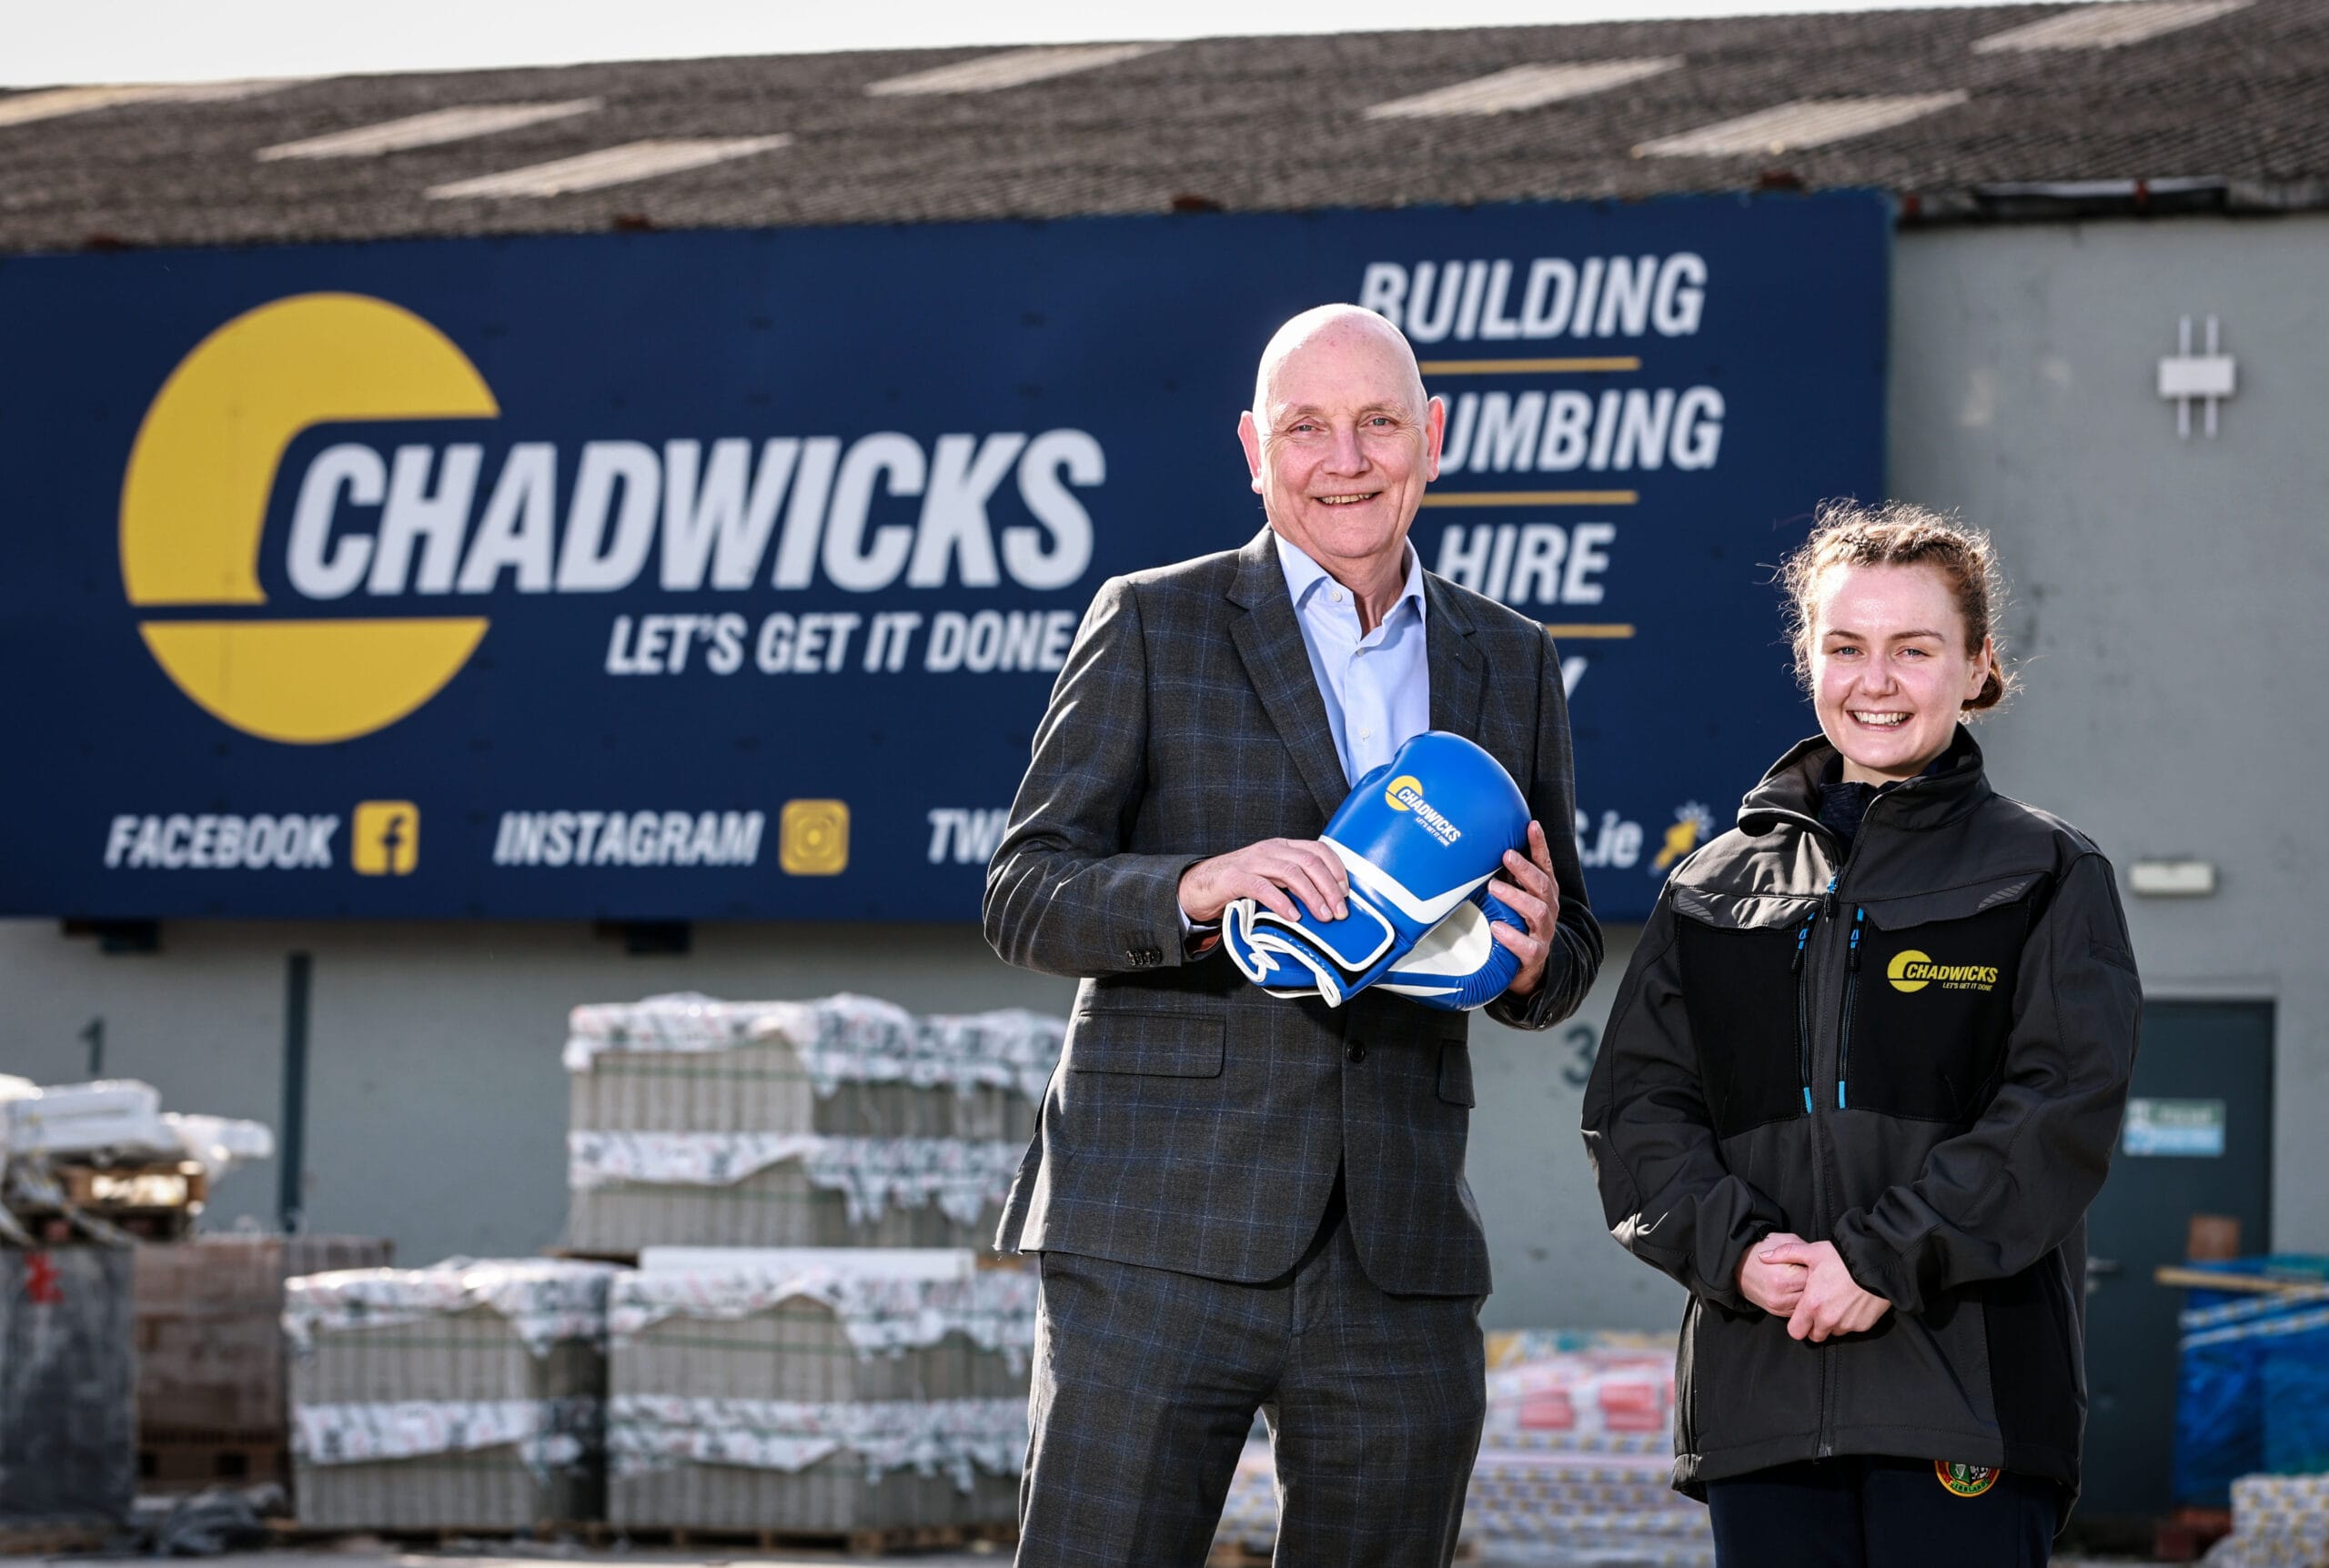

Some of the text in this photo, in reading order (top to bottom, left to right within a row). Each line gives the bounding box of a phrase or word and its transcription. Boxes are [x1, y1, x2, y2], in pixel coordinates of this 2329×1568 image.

[1359, 252, 1709, 343] BUILDING
[1437, 386, 1726, 475] UMBING
[286, 428, 1106, 599] CHADWICKS
[1435, 522, 1617, 604] HIRE
[606, 608, 1076, 675] LET'S GET IT DONE
[105, 814, 339, 869] FACEBOOK
[493, 809, 765, 867] INSTAGRAM
[1397, 788, 1461, 842] CHADWICKS
[1906, 964, 1998, 982] CHADWICKS
[1977, 983, 1992, 991] DONE
